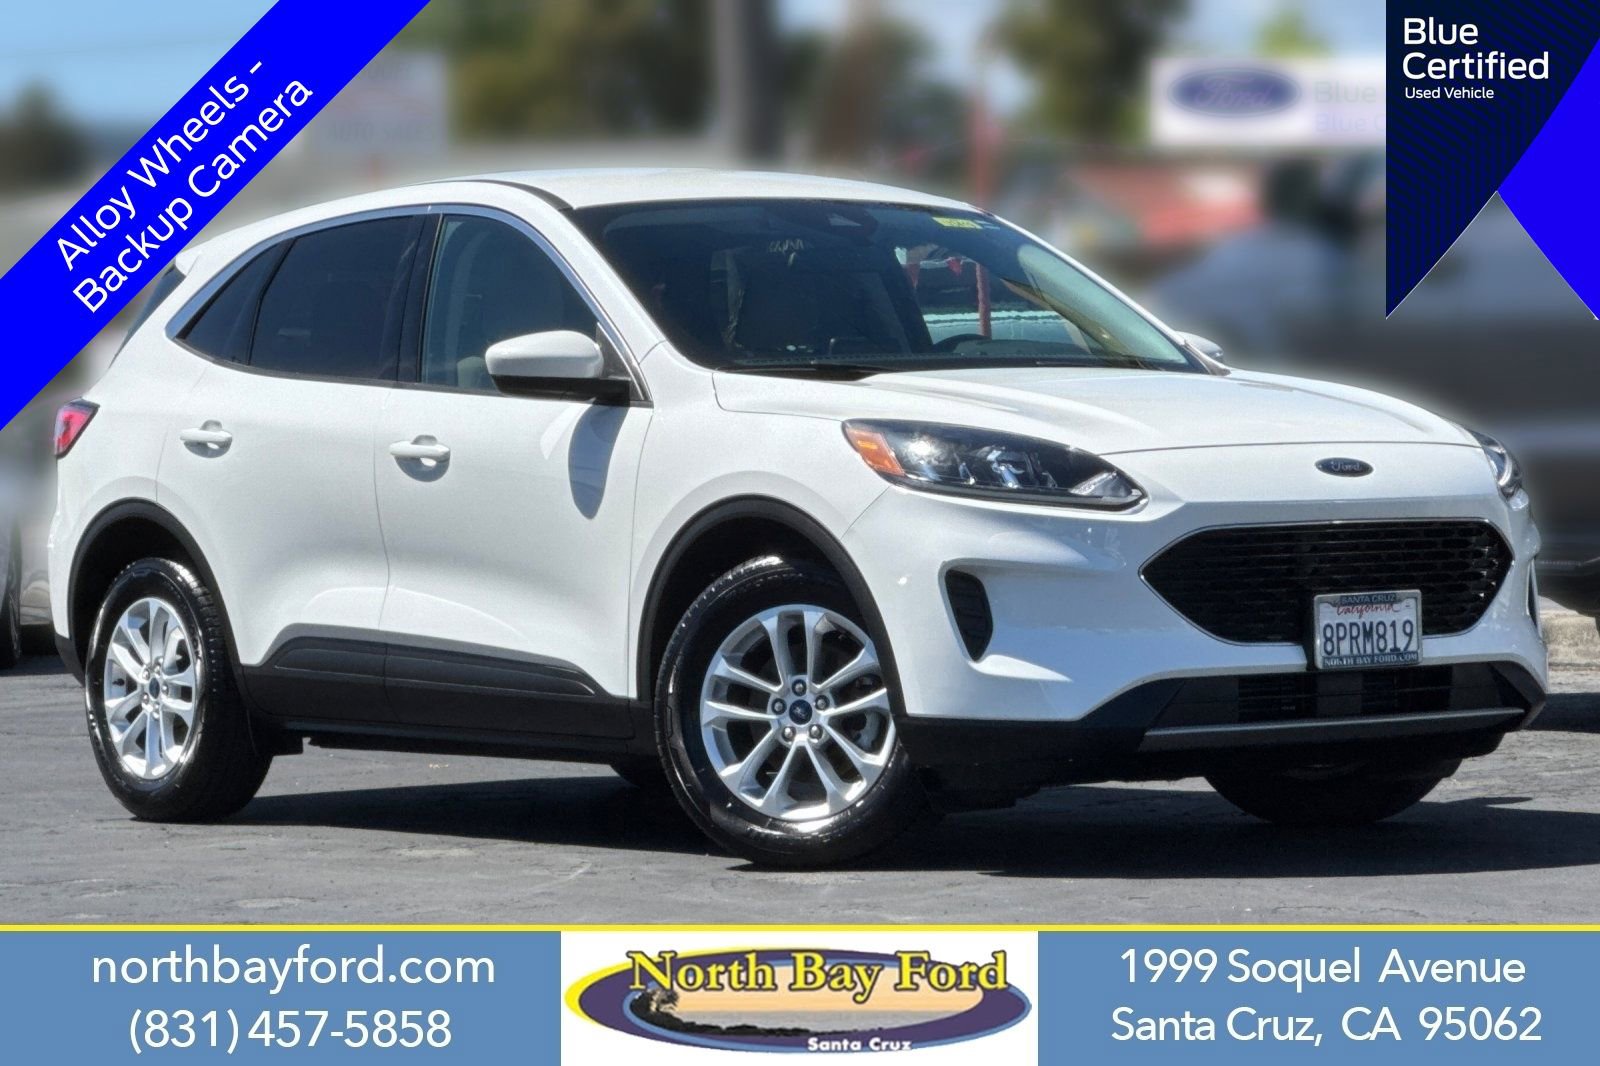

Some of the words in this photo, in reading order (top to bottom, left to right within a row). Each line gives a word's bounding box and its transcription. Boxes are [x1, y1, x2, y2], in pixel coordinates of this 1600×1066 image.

[1193, 75, 1276, 108] Ford
[1314, 80, 1377, 104] Blue
[1315, 112, 1367, 132] Blue
[1322, 619, 1414, 656] 8PRM819
